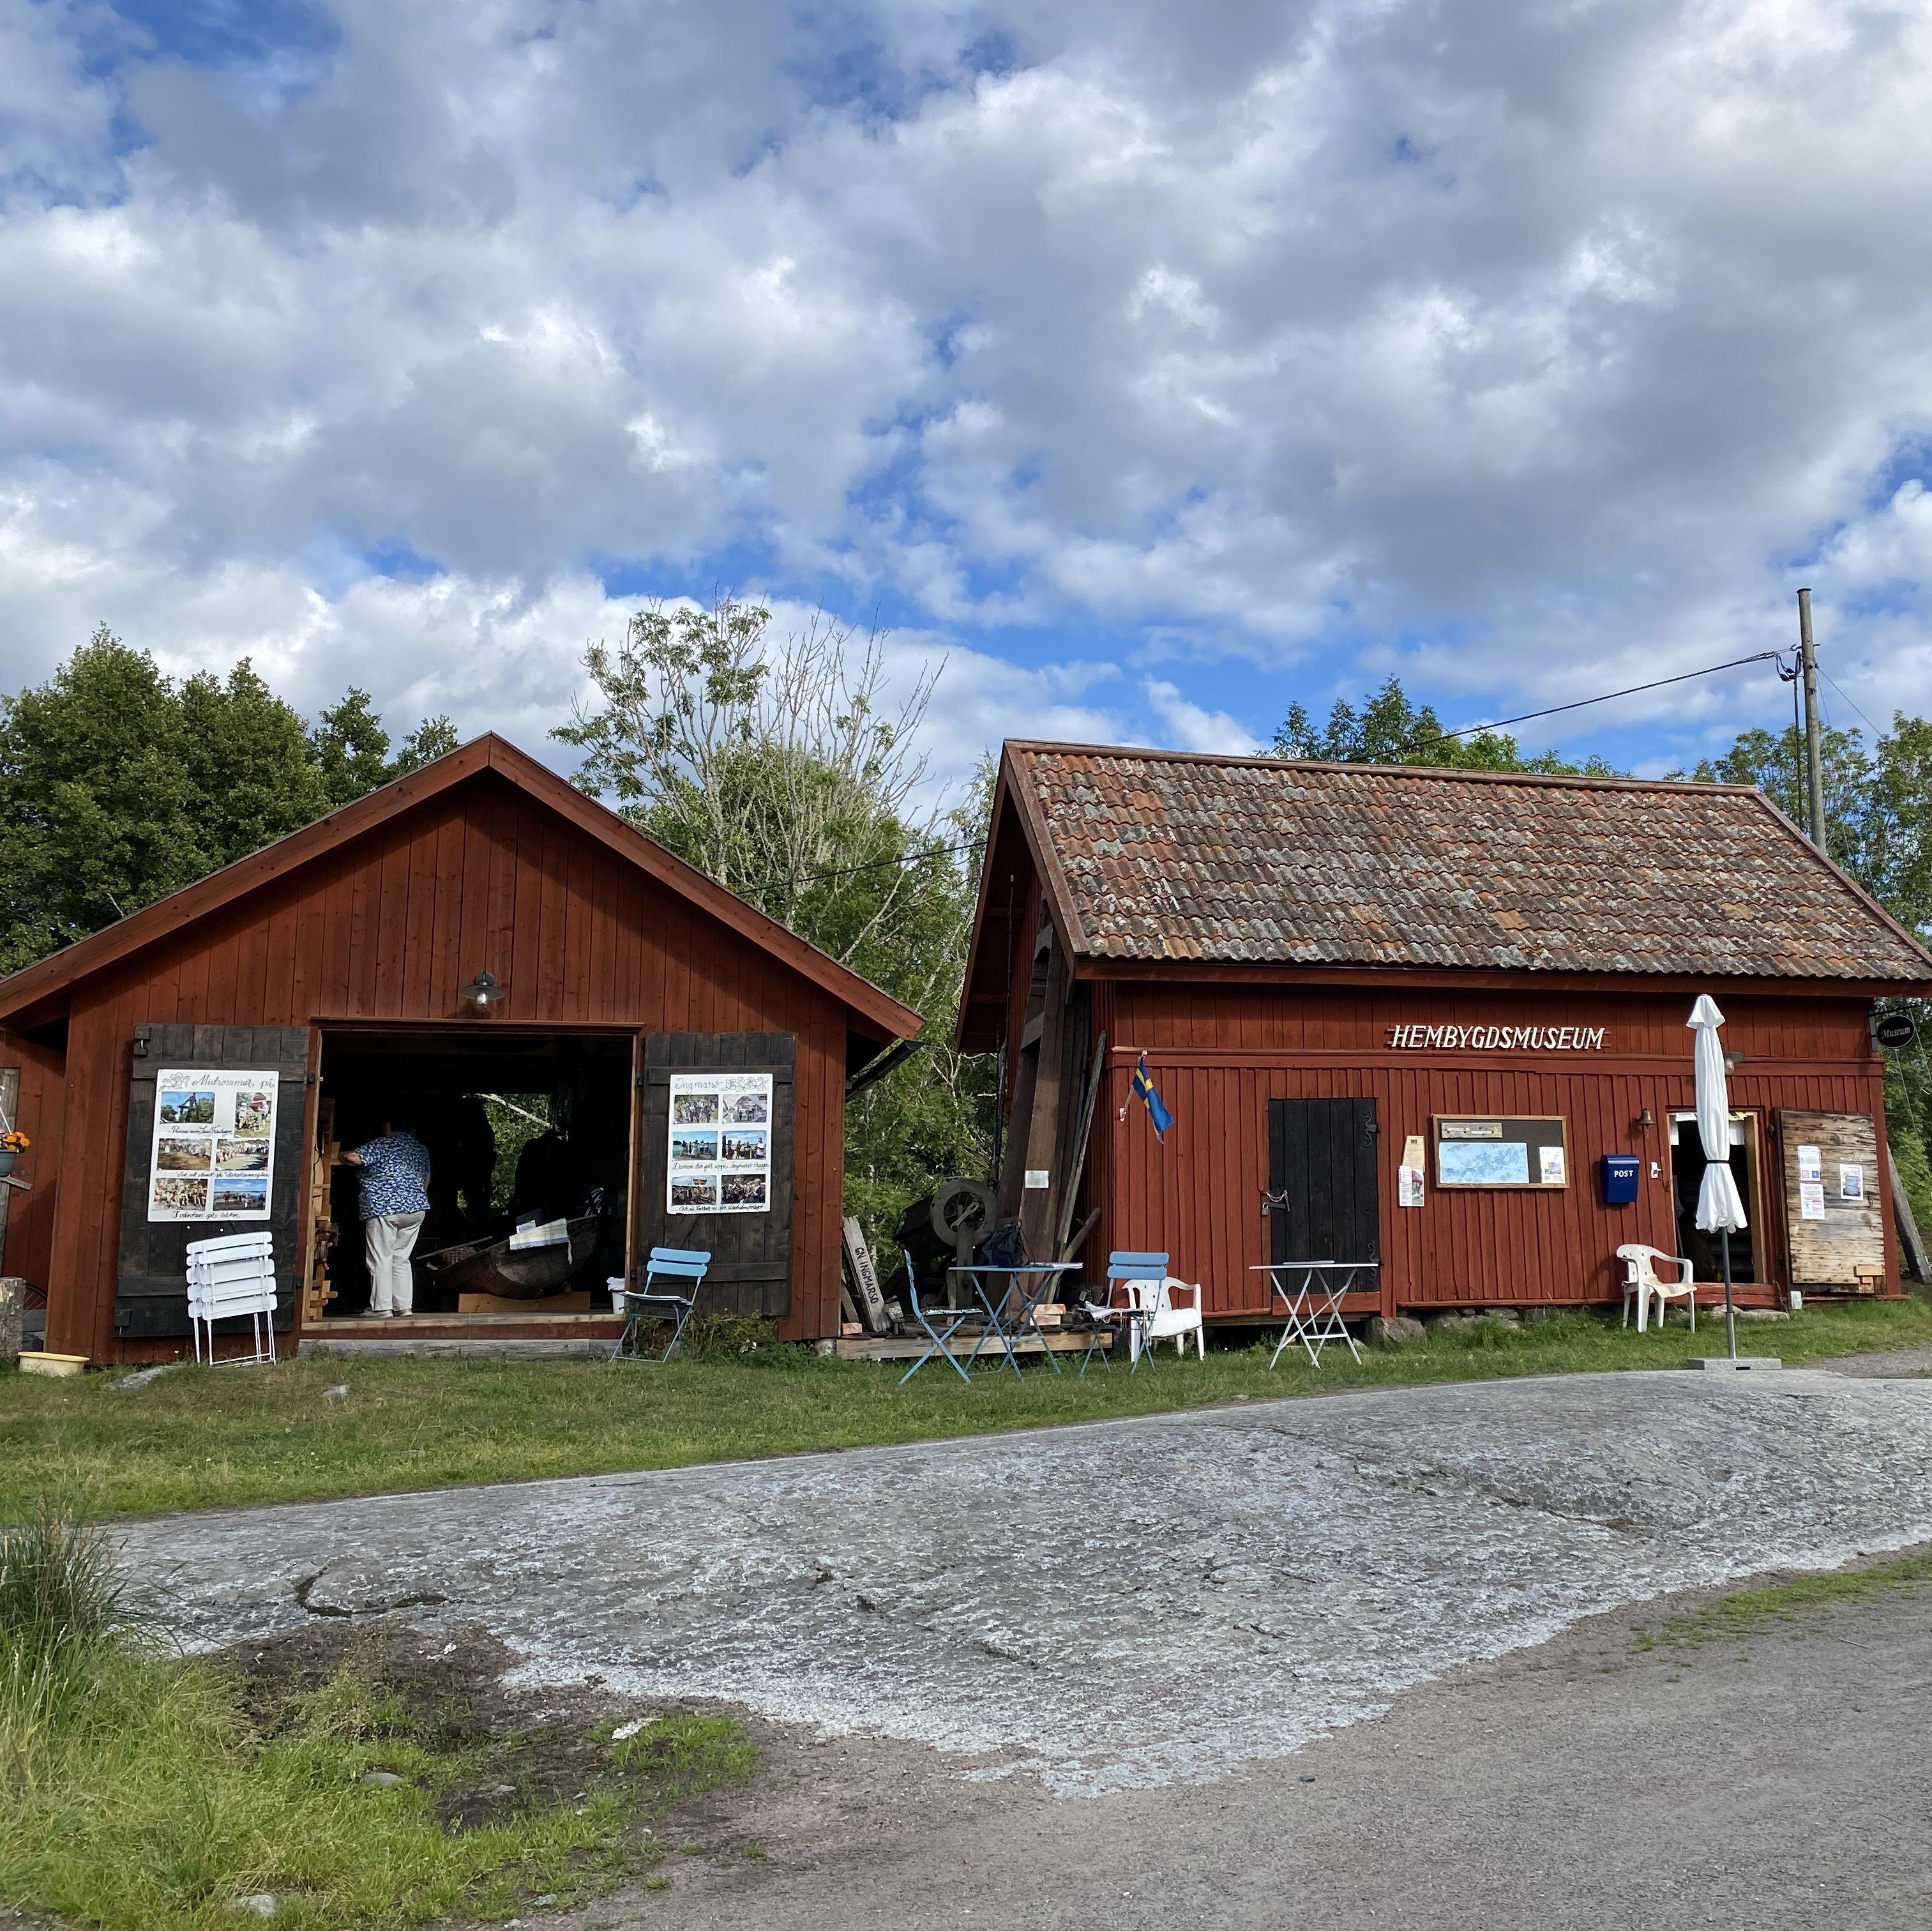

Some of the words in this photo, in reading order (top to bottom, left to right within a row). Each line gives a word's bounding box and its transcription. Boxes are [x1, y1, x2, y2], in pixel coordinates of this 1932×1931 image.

[1391, 1024, 1605, 1050] HEMBYGDSMUSEUM
[1881, 1027, 1910, 1039] Museum
[192, 1073, 254, 1088] Midsommar
[259, 1078, 275, 1090] på
